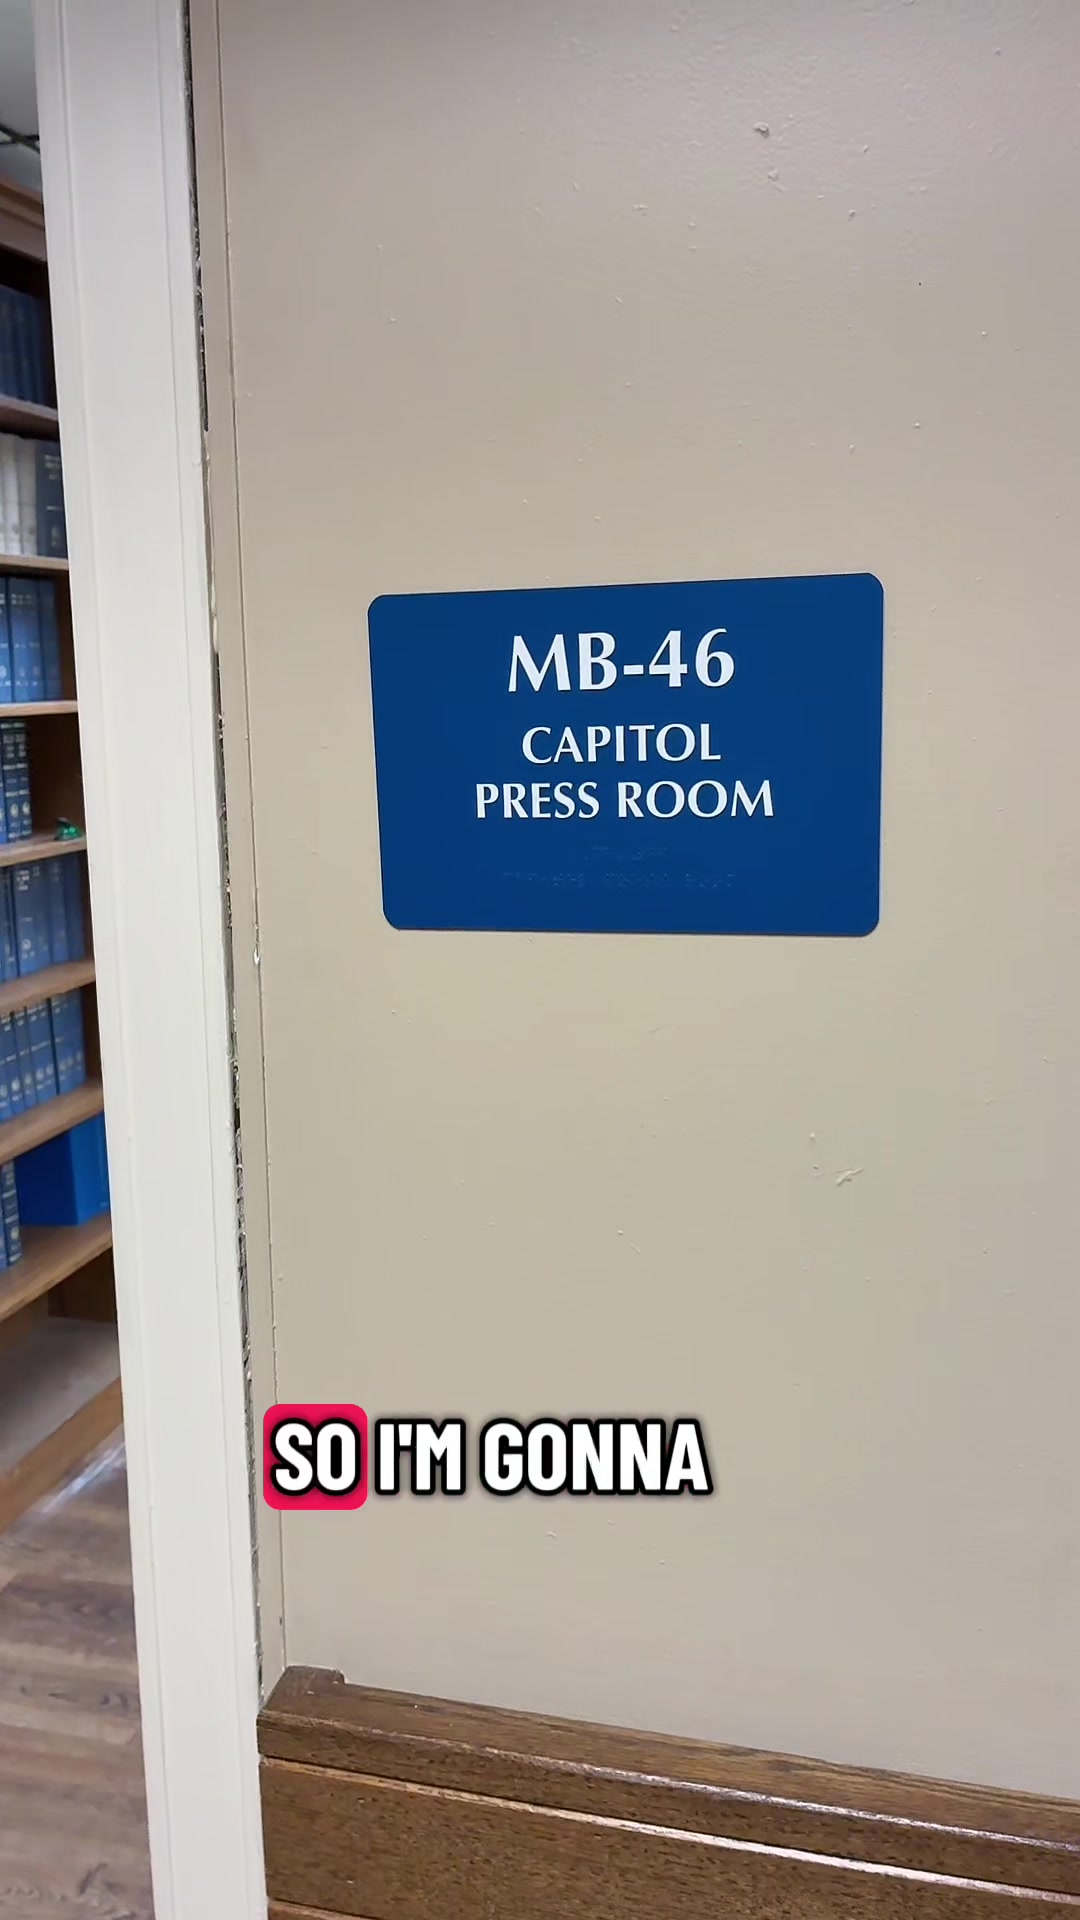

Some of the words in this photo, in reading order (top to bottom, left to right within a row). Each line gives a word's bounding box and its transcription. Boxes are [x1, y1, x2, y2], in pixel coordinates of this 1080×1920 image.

[508, 628, 735, 692] MB-46
[522, 723, 722, 764] CAPITOL
[476, 782, 600, 819] PRESS
[617, 780, 774, 818] ROOM
